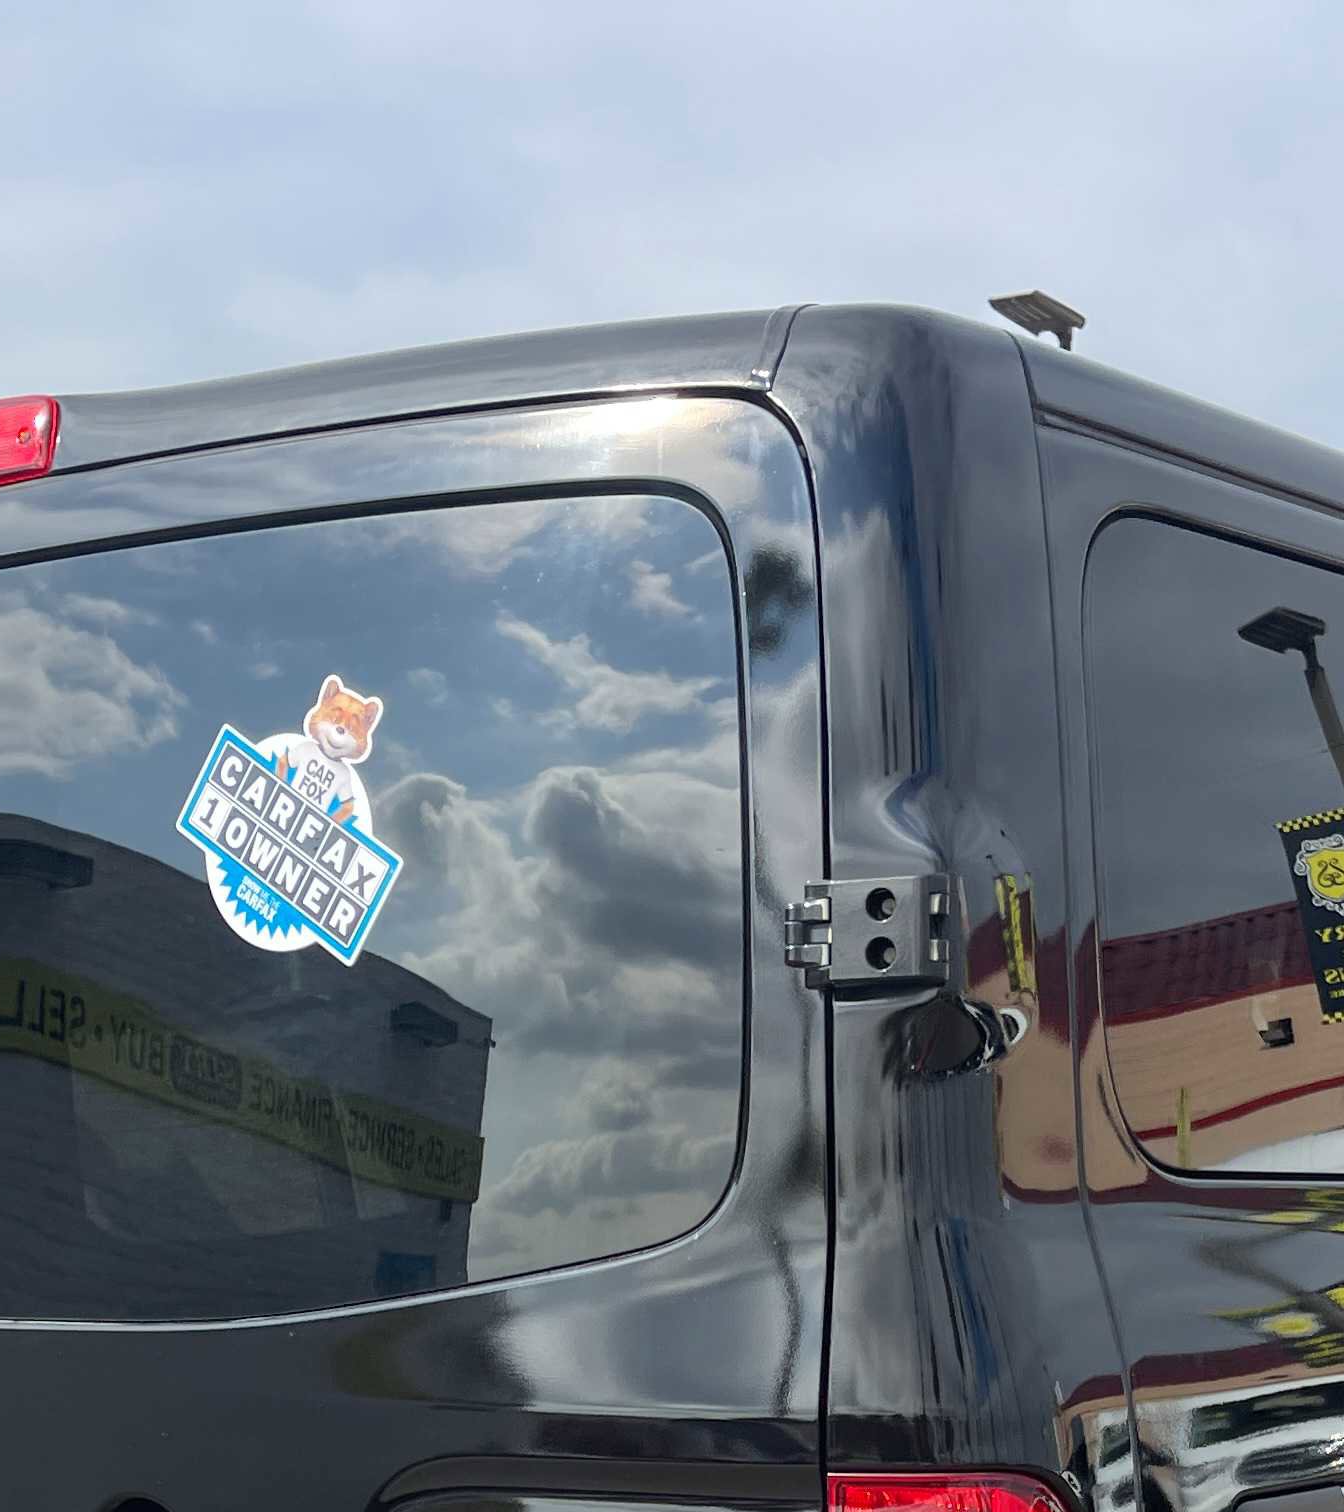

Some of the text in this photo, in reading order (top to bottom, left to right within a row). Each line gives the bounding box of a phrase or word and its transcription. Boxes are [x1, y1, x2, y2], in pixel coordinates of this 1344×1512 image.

[298, 776, 327, 805] FOX
[306, 759, 335, 788] CAR
[200, 798, 356, 937] 1 OWNER
[220, 756, 376, 899] CARFAX
